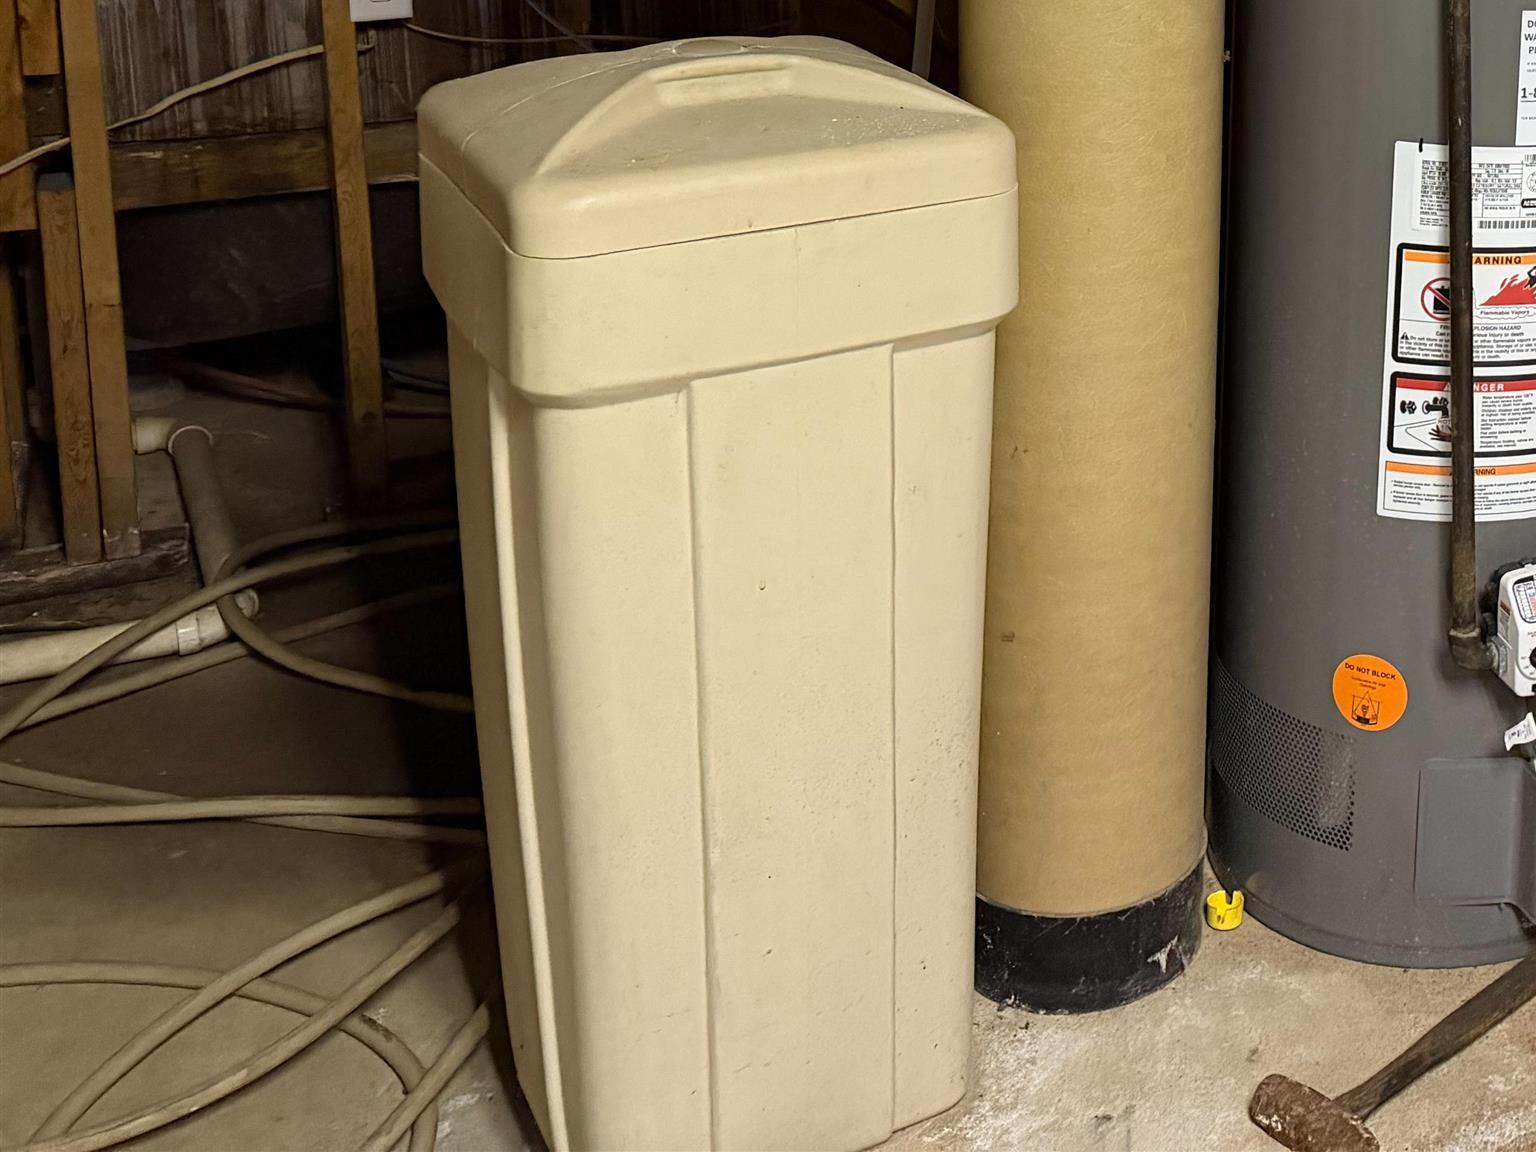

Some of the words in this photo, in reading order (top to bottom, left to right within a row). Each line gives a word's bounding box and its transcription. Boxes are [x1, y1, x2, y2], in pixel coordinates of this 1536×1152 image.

[1474, 256, 1522, 265] ARNING
[1473, 383, 1504, 392] NGER
[1475, 468, 1496, 476] RNING
[1356, 666, 1370, 675] NOT
[1372, 671, 1396, 680] BLOCK
